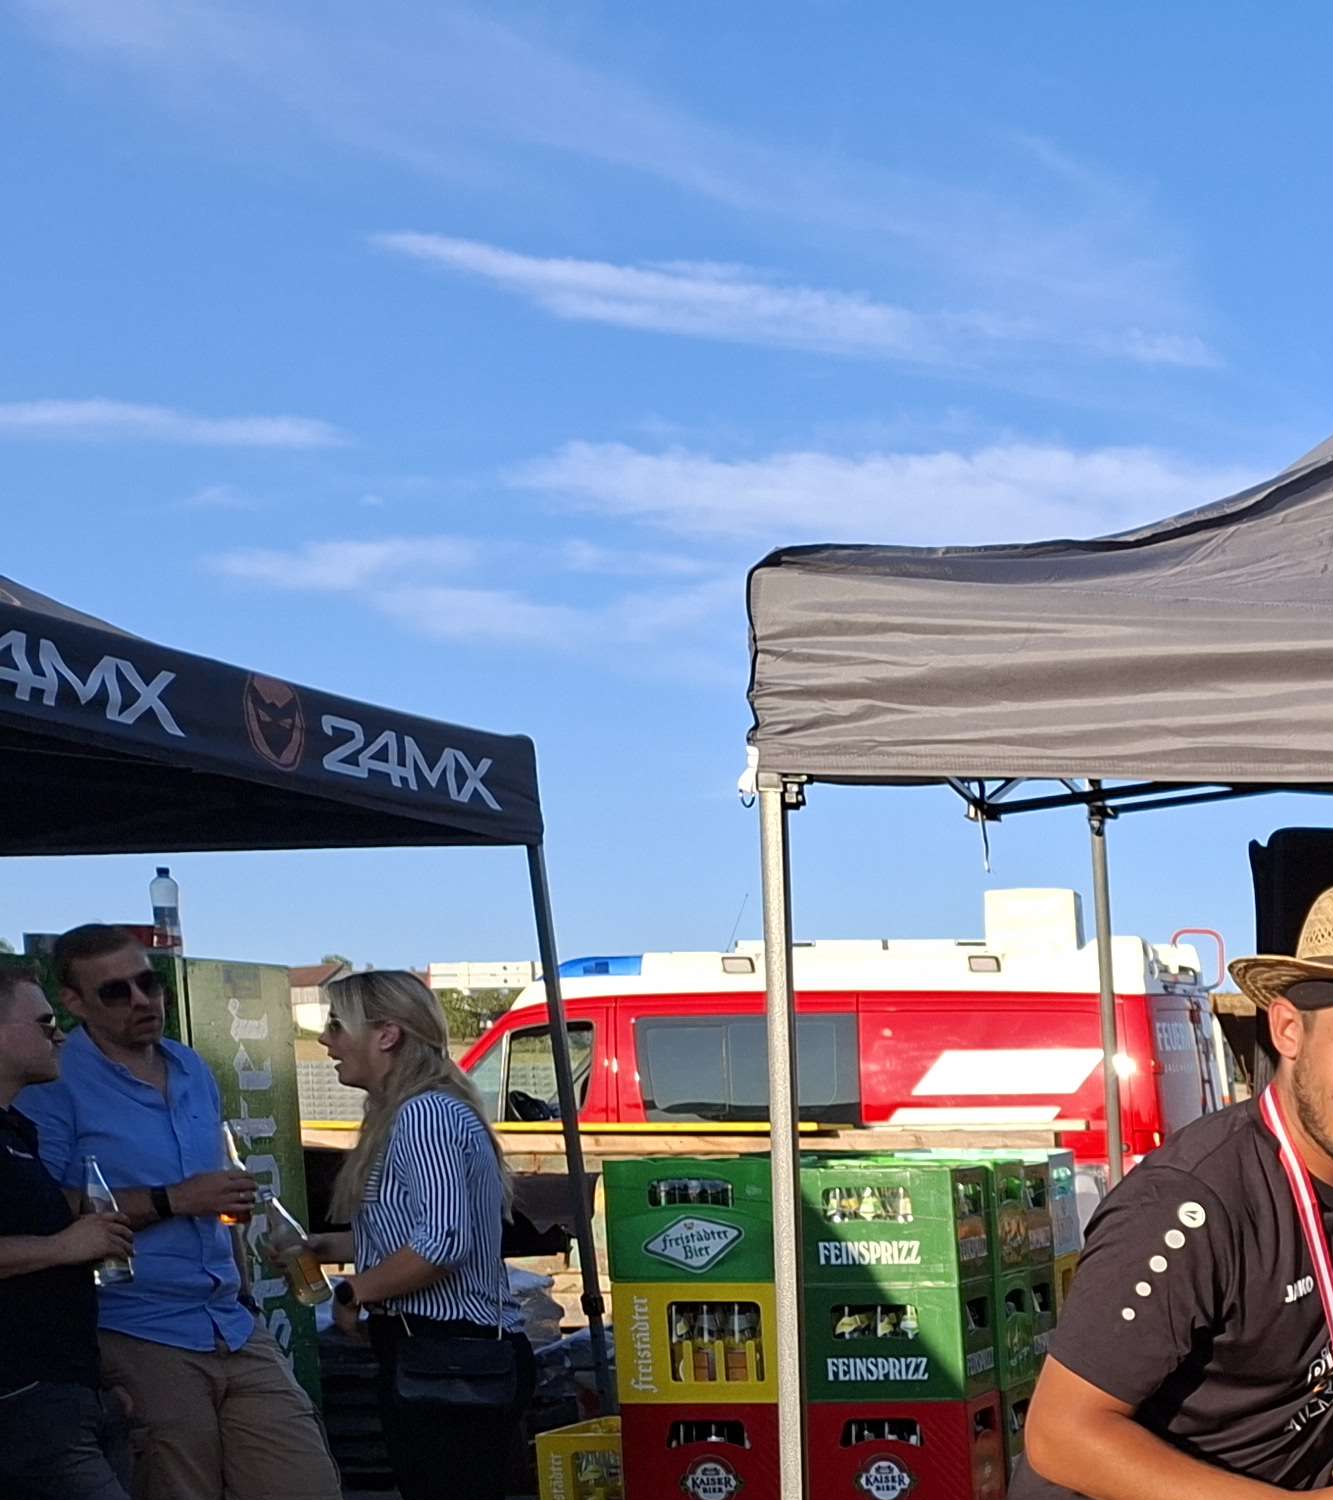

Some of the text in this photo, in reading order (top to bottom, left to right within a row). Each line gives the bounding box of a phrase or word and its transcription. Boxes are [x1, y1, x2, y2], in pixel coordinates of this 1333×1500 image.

[321, 714, 503, 812] 24MX
[683, 1244, 711, 1260] Bier
[818, 1240, 921, 1265] FEINSPRIZZ
[826, 1357, 929, 1381] FEINSPRIZZ
[691, 1476, 733, 1489] KAISER
[865, 1474, 907, 1487] KAISER
